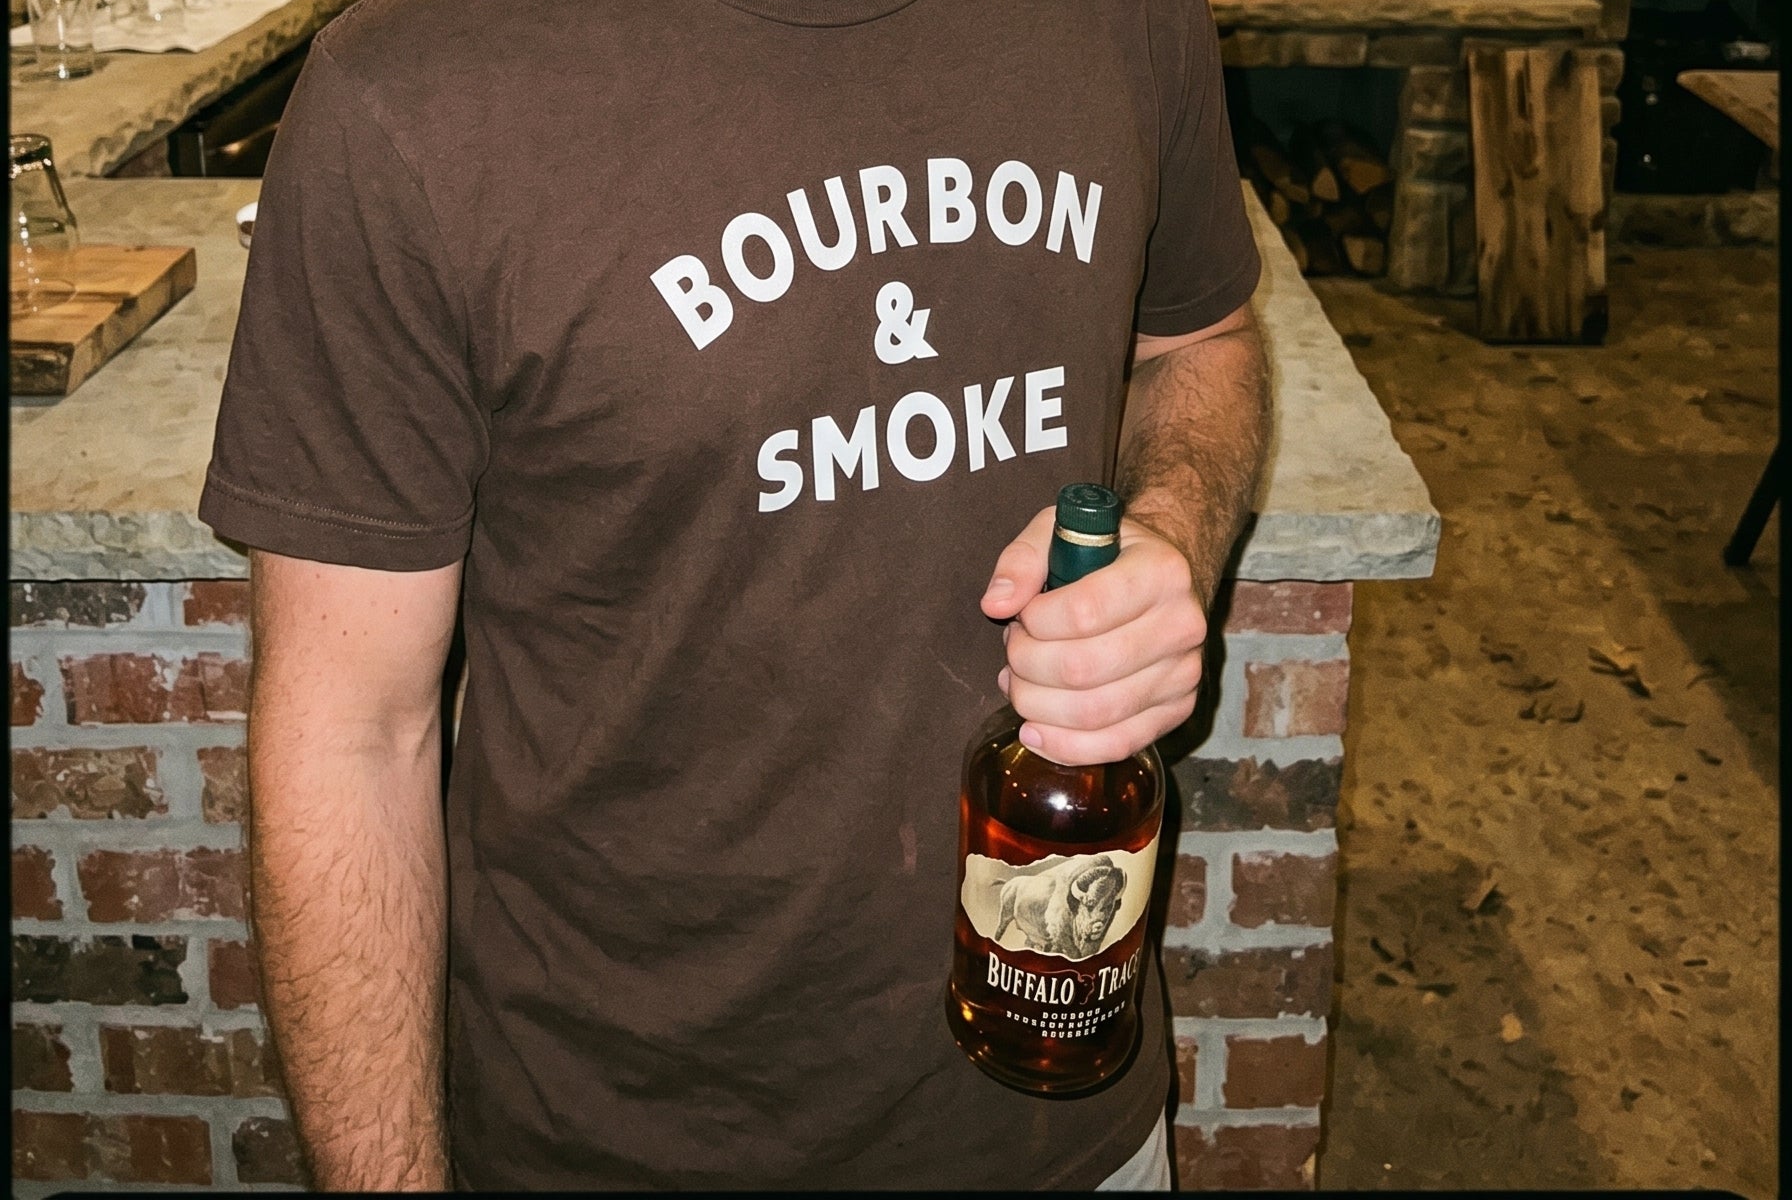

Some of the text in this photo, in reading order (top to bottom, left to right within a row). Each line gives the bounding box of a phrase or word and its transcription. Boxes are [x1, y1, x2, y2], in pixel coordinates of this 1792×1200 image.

[650, 158, 1103, 351] BOURBON
[874, 281, 939, 364] &
[757, 365, 1068, 513] SMOKE
[987, 951, 1075, 1005] BUFFALO
